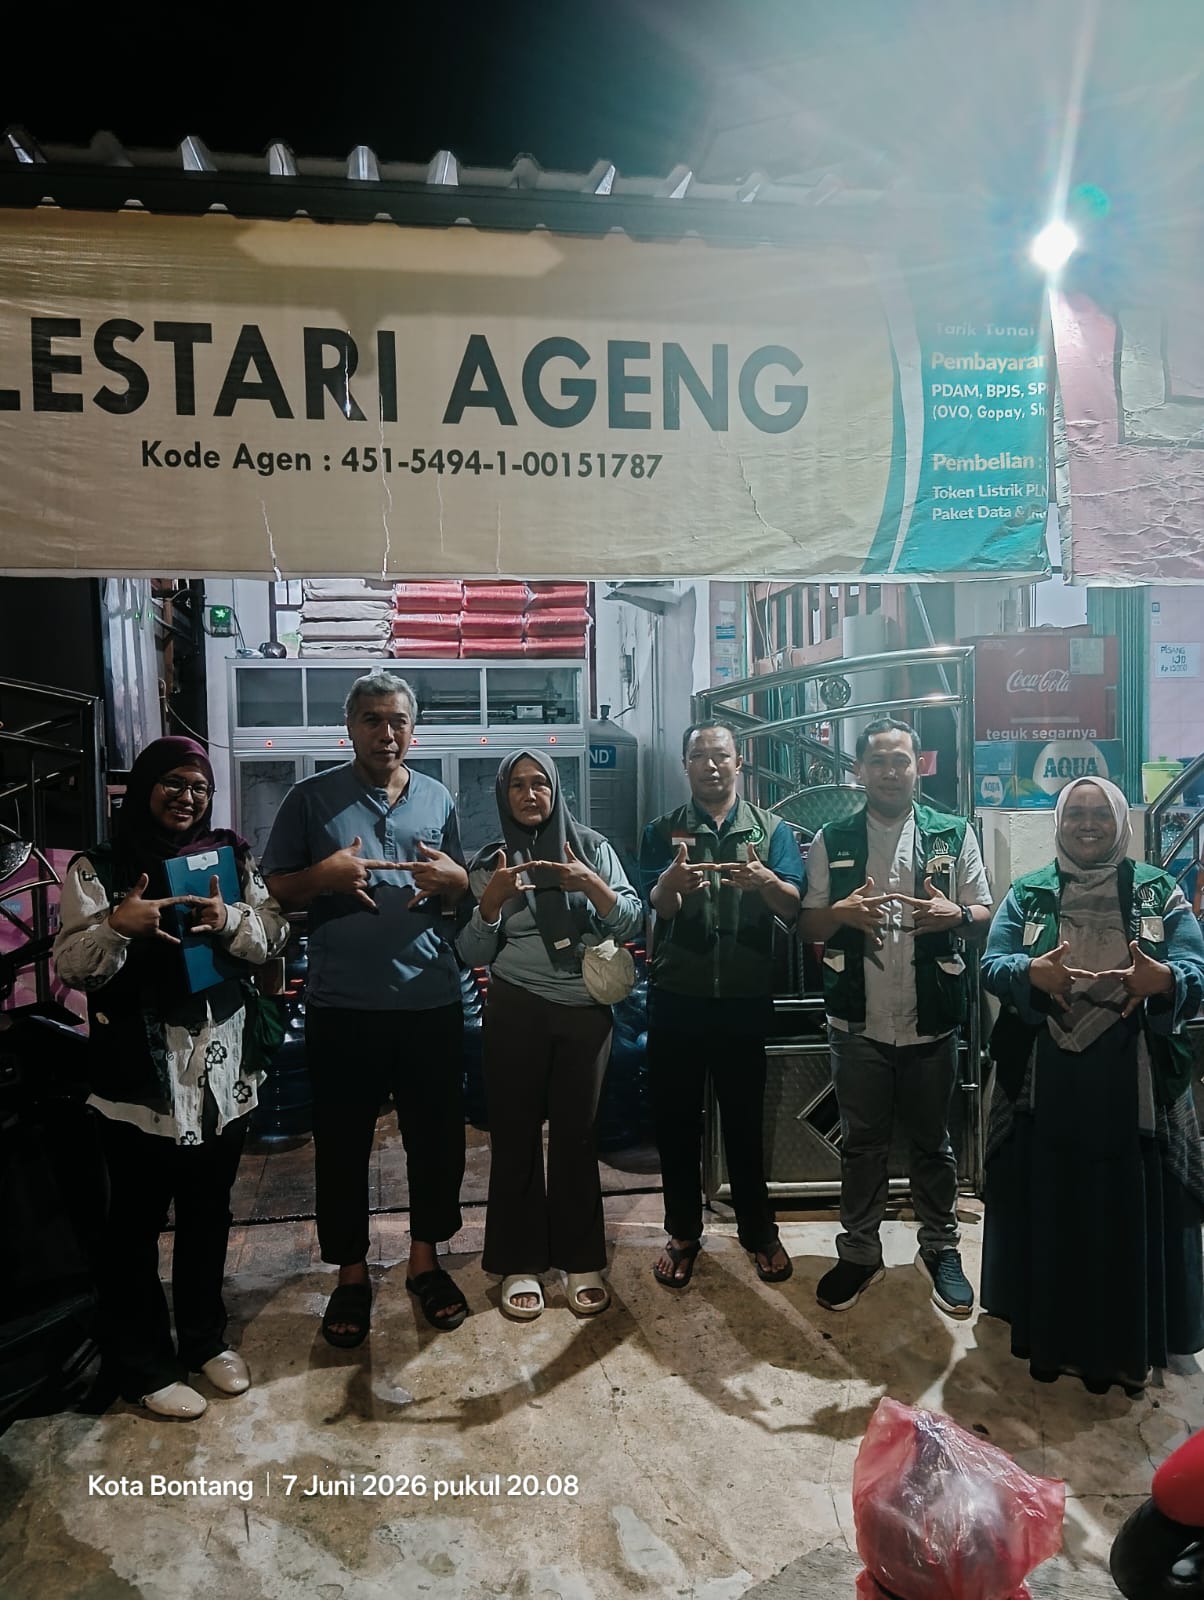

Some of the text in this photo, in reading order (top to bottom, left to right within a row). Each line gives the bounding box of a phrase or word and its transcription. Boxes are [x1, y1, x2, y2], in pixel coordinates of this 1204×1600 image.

[442, 334, 809, 434] AGENG
[932, 382, 1048, 399] PDAM, BPJS, SP
[933, 402, 1048, 422] (OVO, Gopay, Sh
[141, 440, 220, 469] Kode
[232, 443, 311, 476] Agen
[341, 446, 663, 480] 451-5494-1-00151787
[932, 452, 1034, 472] Pembelian
[932, 485, 975, 499] Token
[978, 483, 1023, 498] Listrik
[932, 507, 975, 521] Paket
[977, 505, 1012, 519] Data
[1006, 669, 1072, 693] Coca-Cola
[986, 727, 1098, 741] teguk segarnya
[1043, 757, 1100, 778] AQUA
